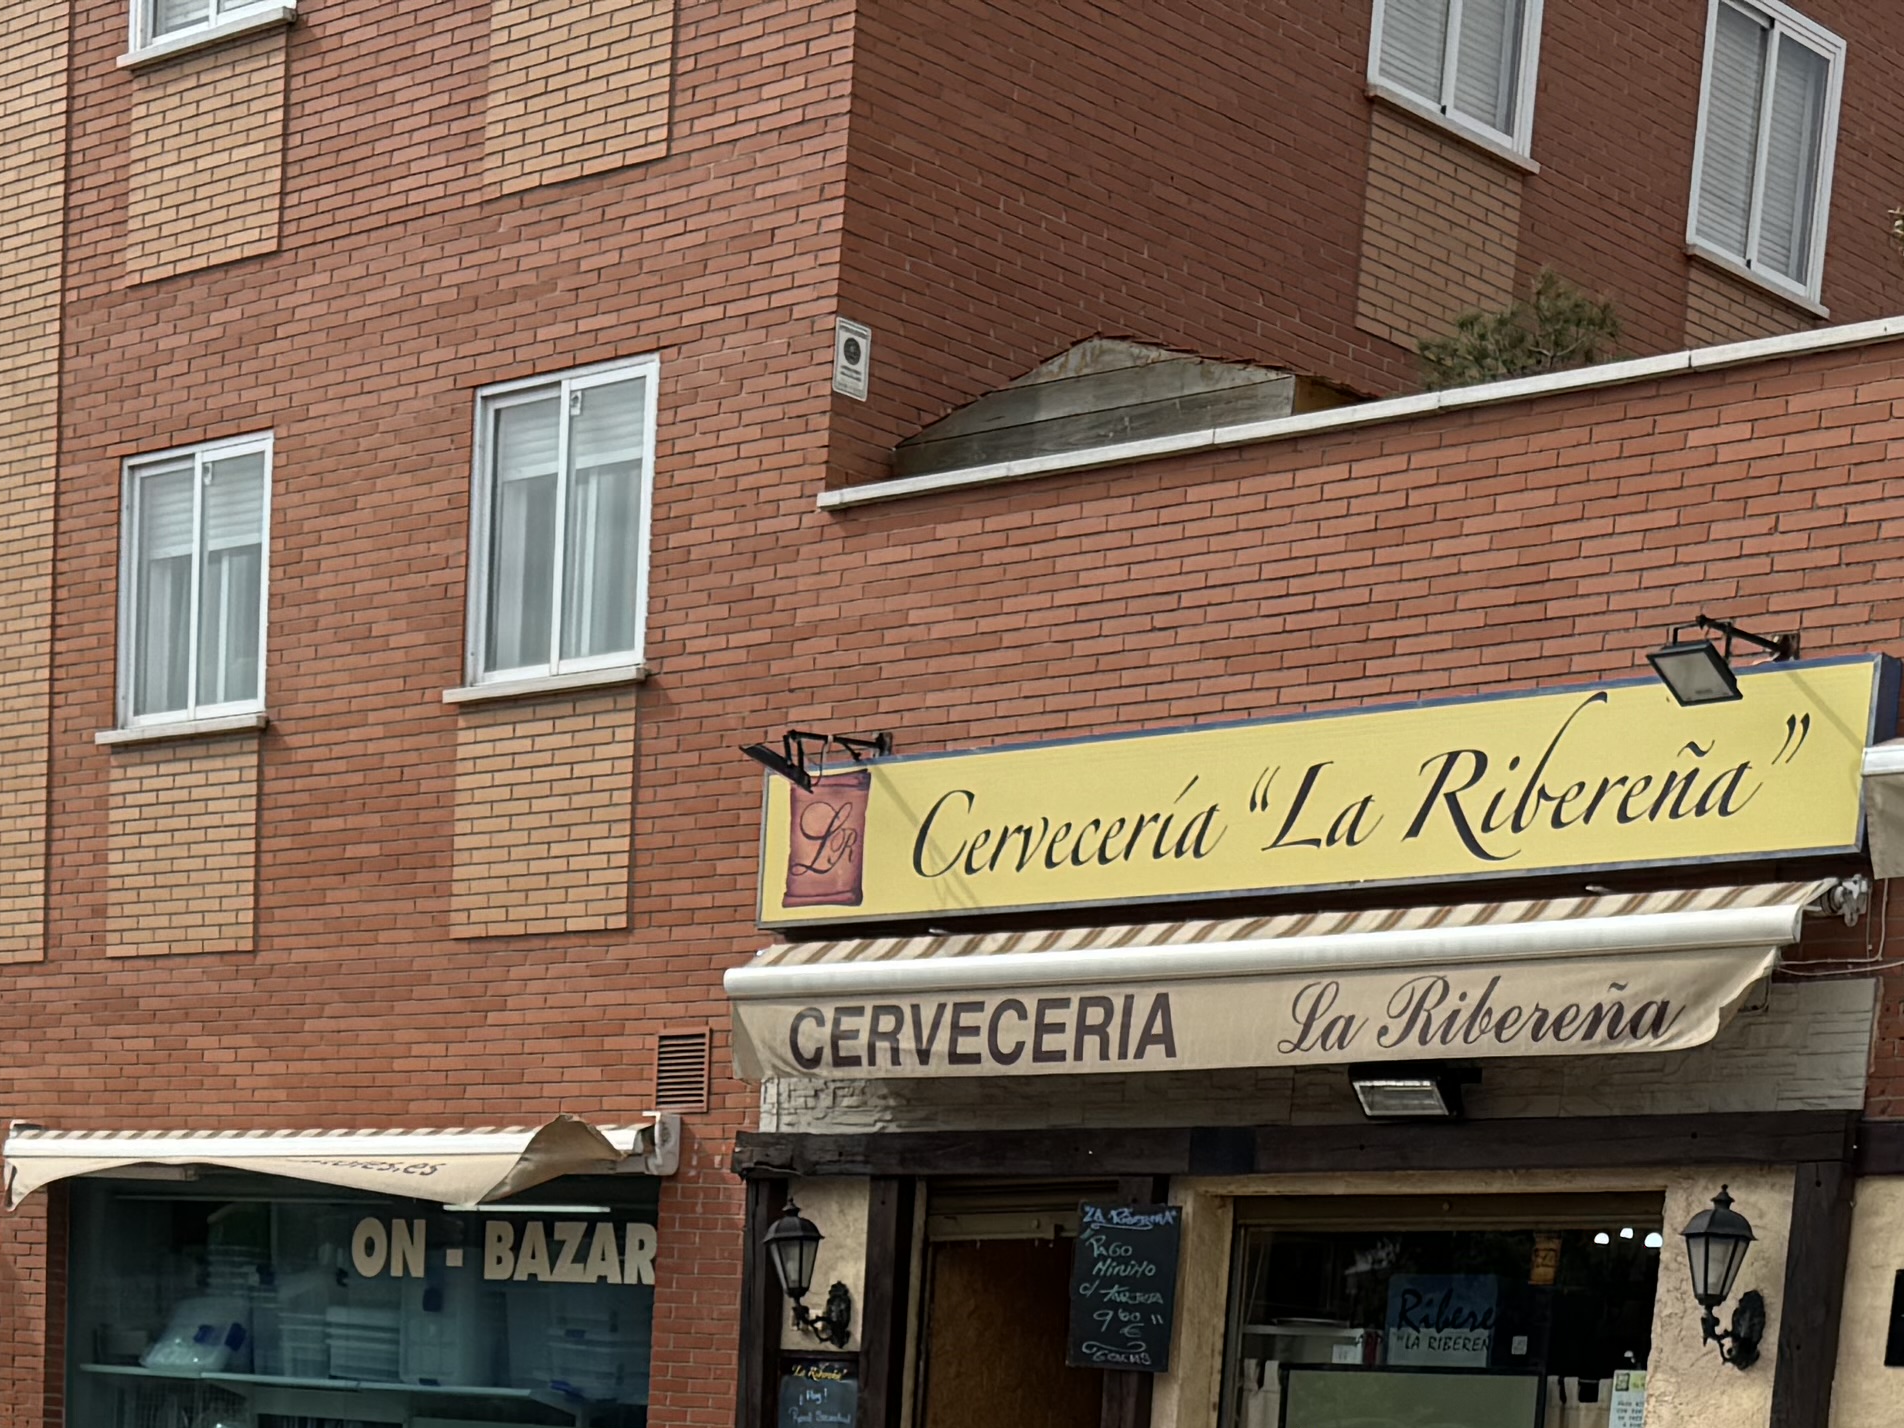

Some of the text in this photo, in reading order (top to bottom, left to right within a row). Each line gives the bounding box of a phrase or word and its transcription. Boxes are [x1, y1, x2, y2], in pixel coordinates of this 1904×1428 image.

[911, 774, 1227, 879] Cervecería
[789, 976, 1688, 1072] CERVECERIA La Ribereña
[351, 1216, 427, 1279] ON
[484, 1220, 658, 1285] BAZAR
